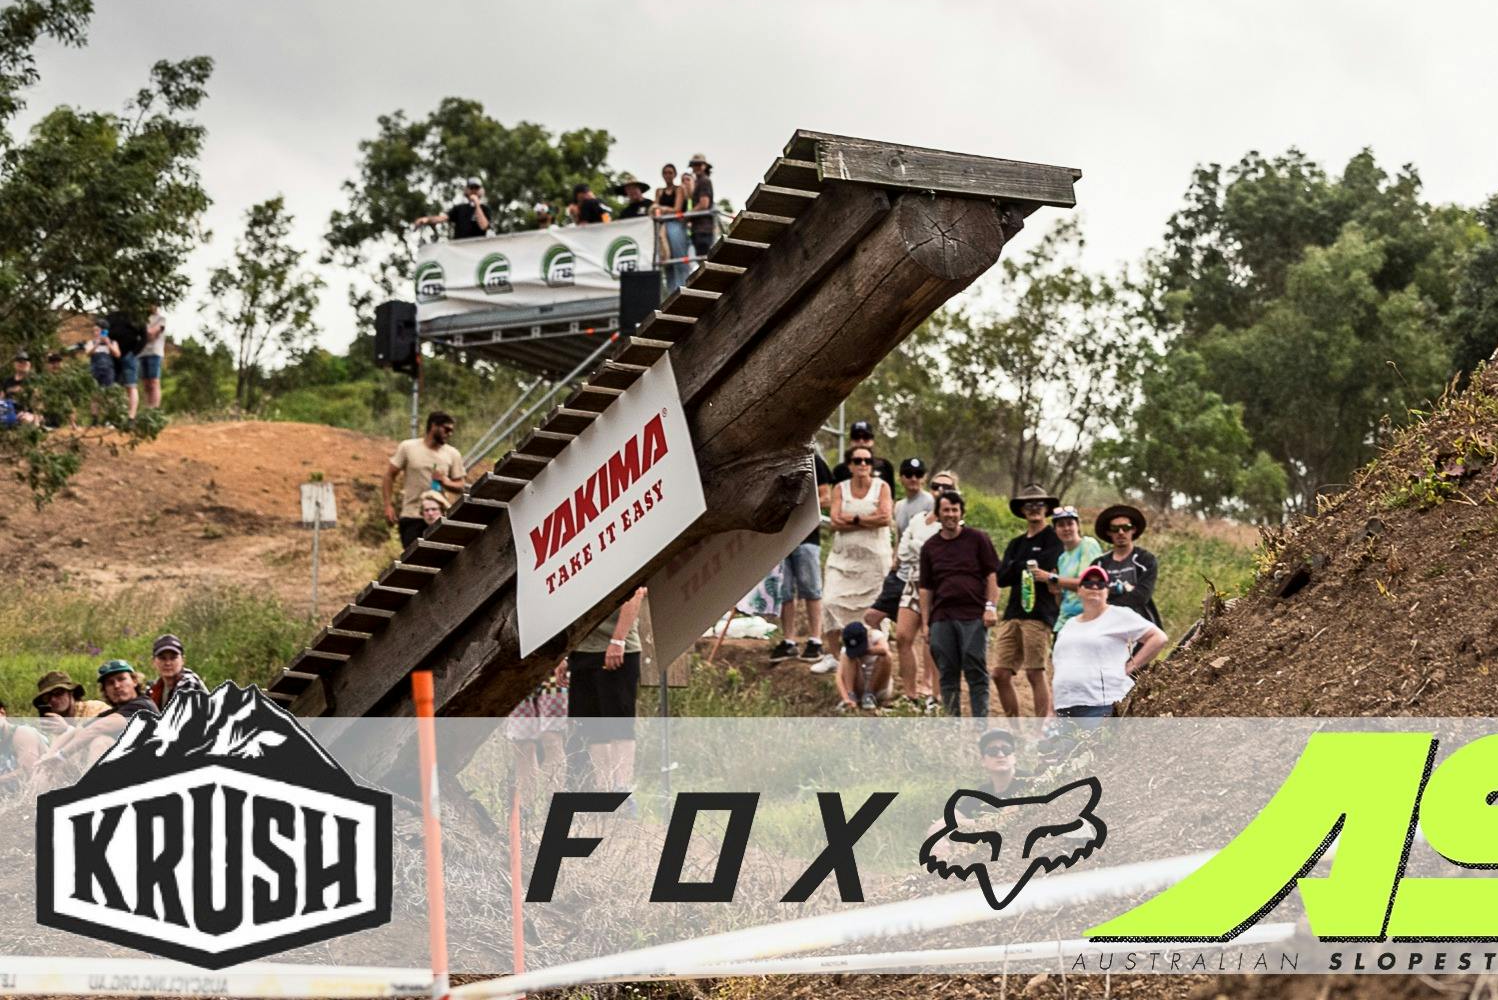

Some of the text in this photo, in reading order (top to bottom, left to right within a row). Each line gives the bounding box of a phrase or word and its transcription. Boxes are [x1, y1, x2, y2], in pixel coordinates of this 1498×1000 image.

[546, 479, 663, 594] TAKE IT EASY
